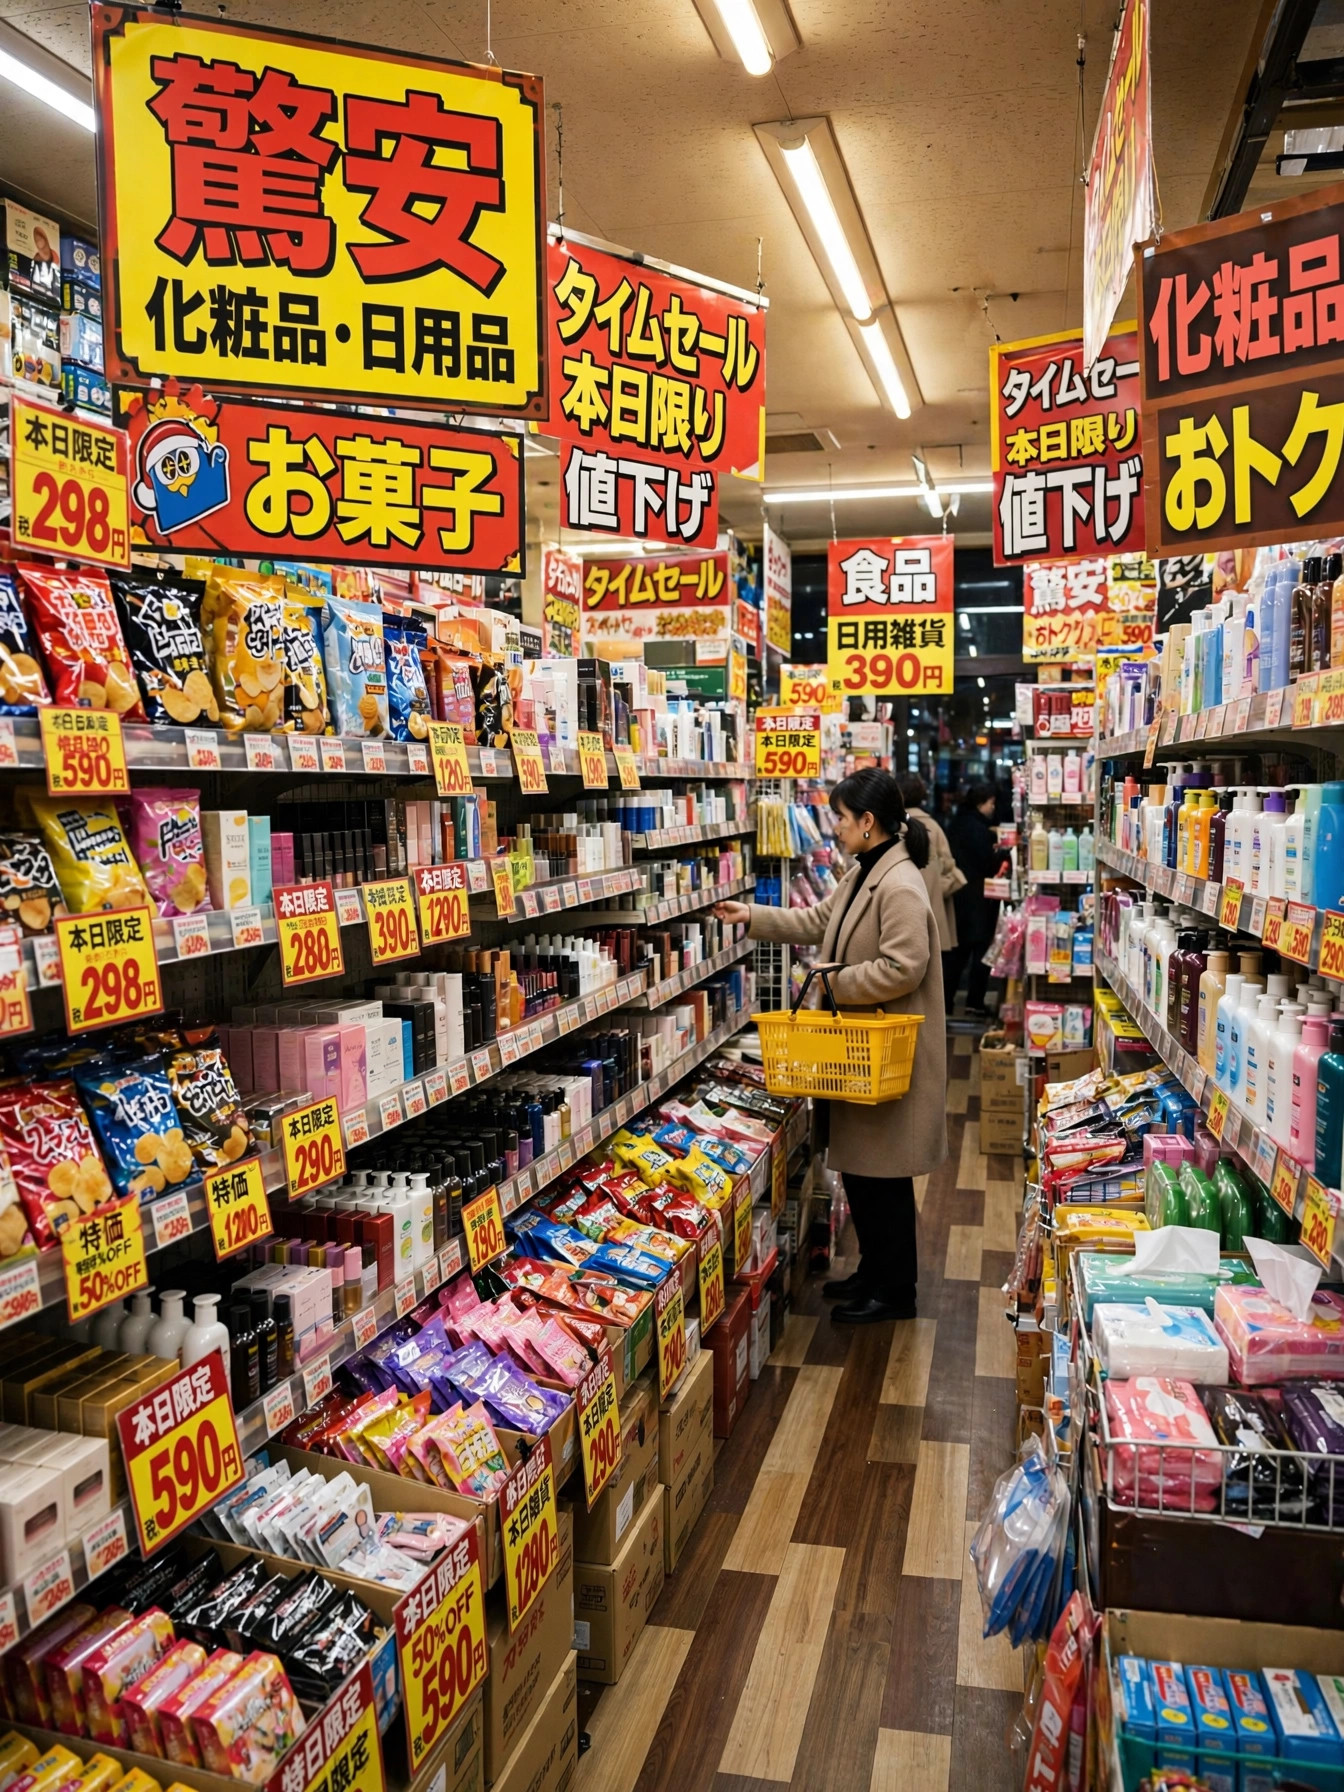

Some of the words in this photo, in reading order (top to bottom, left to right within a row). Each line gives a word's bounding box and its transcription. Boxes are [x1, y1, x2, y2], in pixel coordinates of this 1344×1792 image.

[147, 53, 507, 298] 驚安
[145, 276, 516, 384] 化粧品・日用品
[553, 258, 758, 391] タイムセール
[1149, 233, 1344, 382] 化粧品
[561, 351, 725, 461] 本日限り
[25, 415, 116, 472] 本日限定
[1005, 409, 1138, 467] 本日限り
[245, 426, 505, 552] お菓子
[564, 449, 713, 540] 値下げ
[999, 457, 1142, 559] 値下げ
[584, 558, 725, 608] タイムセール
[840, 547, 937, 606] 食品
[837, 618, 946, 650] 日用雑貨
[760, 734, 816, 748] 本日限定
[762, 716, 815, 732] 本日限定
[280, 887, 329, 917] 本日限定
[421, 866, 464, 894] 本日限定
[69, 916, 144, 953] 本日限定
[288, 1104, 335, 1140] 本日限定
[211, 1171, 249, 1208] 特価
[79, 1212, 124, 1256] 特価
[80, 1261, 141, 1310] 50%OFF
[132, 1366, 215, 1447] 本日限定
[402, 1537, 470, 1636] 本日限定
[411, 1580, 475, 1679] 50%OFF
